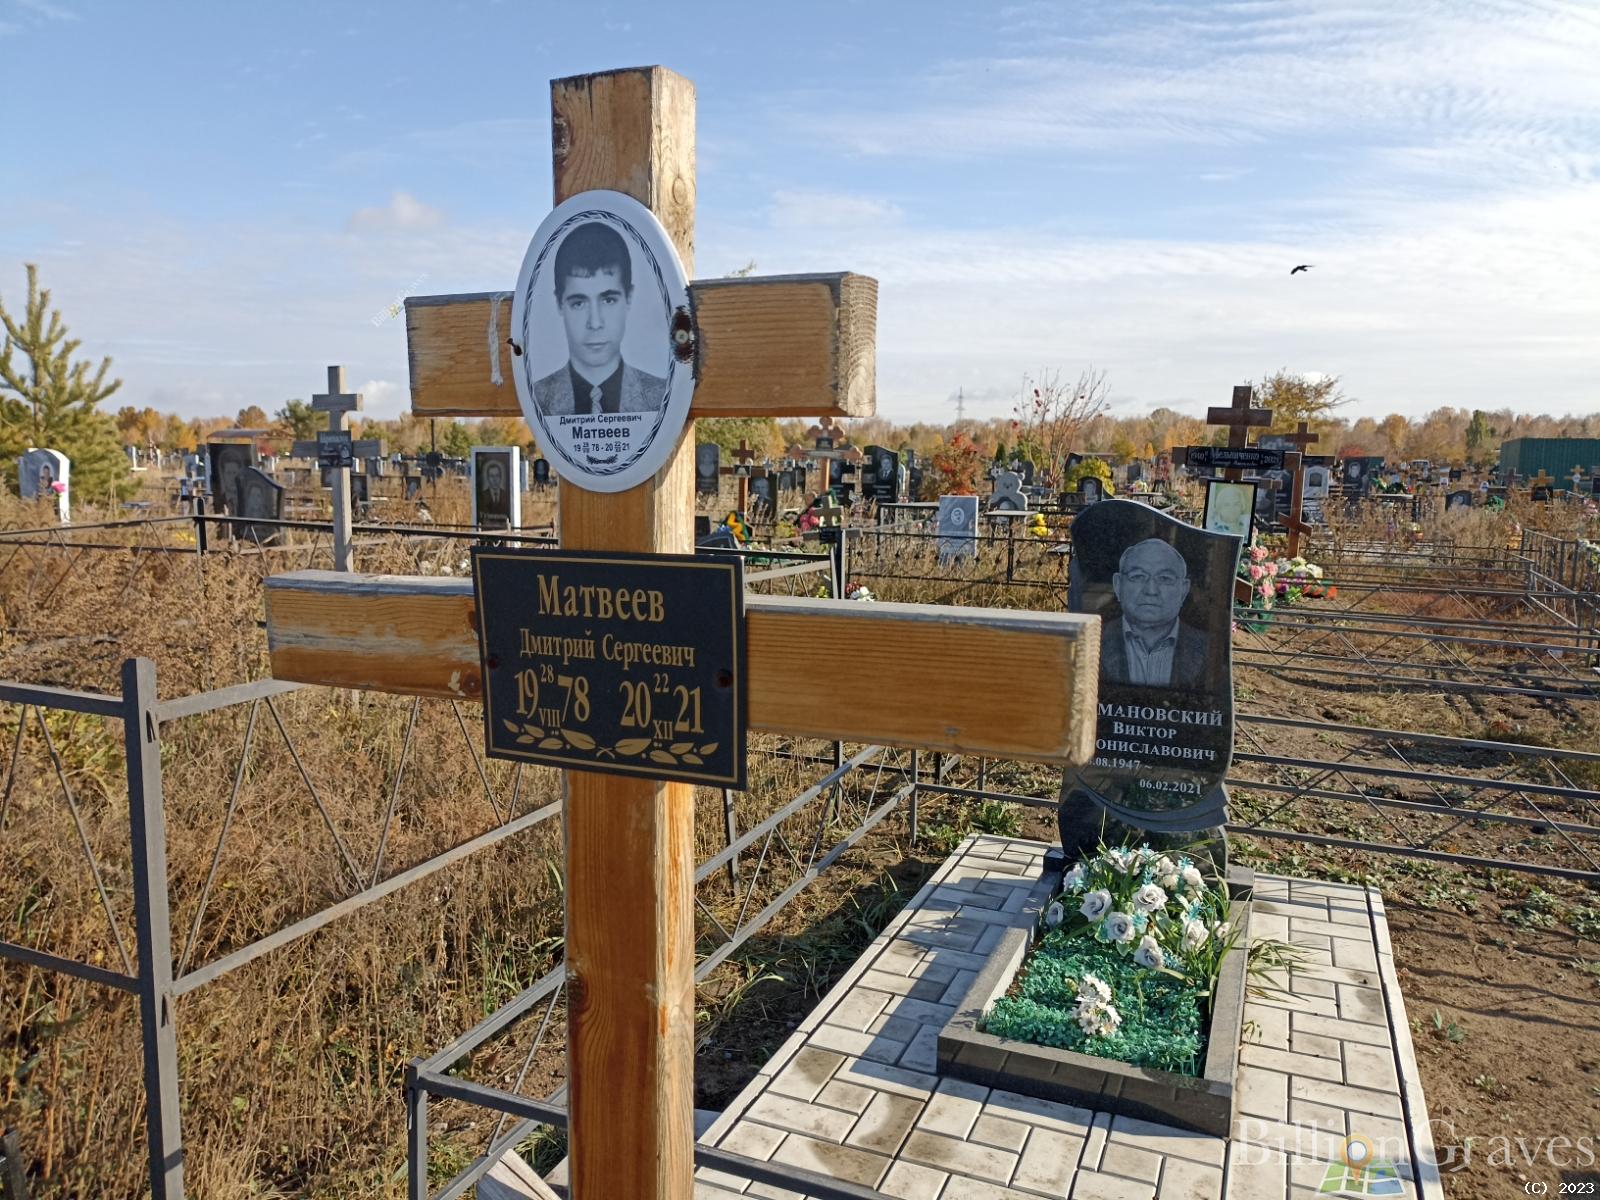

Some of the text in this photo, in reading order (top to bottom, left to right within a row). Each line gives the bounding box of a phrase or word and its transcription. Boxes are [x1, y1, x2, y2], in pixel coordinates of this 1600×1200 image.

[560, 415, 641, 425] Дмитрий Сергеевич
[572, 426, 630, 439] Матвеев
[537, 574, 665, 624] Матвеев
[519, 628, 695, 670] Дмитрий Сергеевич
[540, 664, 554, 684] 28
[654, 673, 669, 693] 22
[514, 669, 704, 734] 19 78 20 21
[1139, 778, 1202, 795] 06.02.2021
